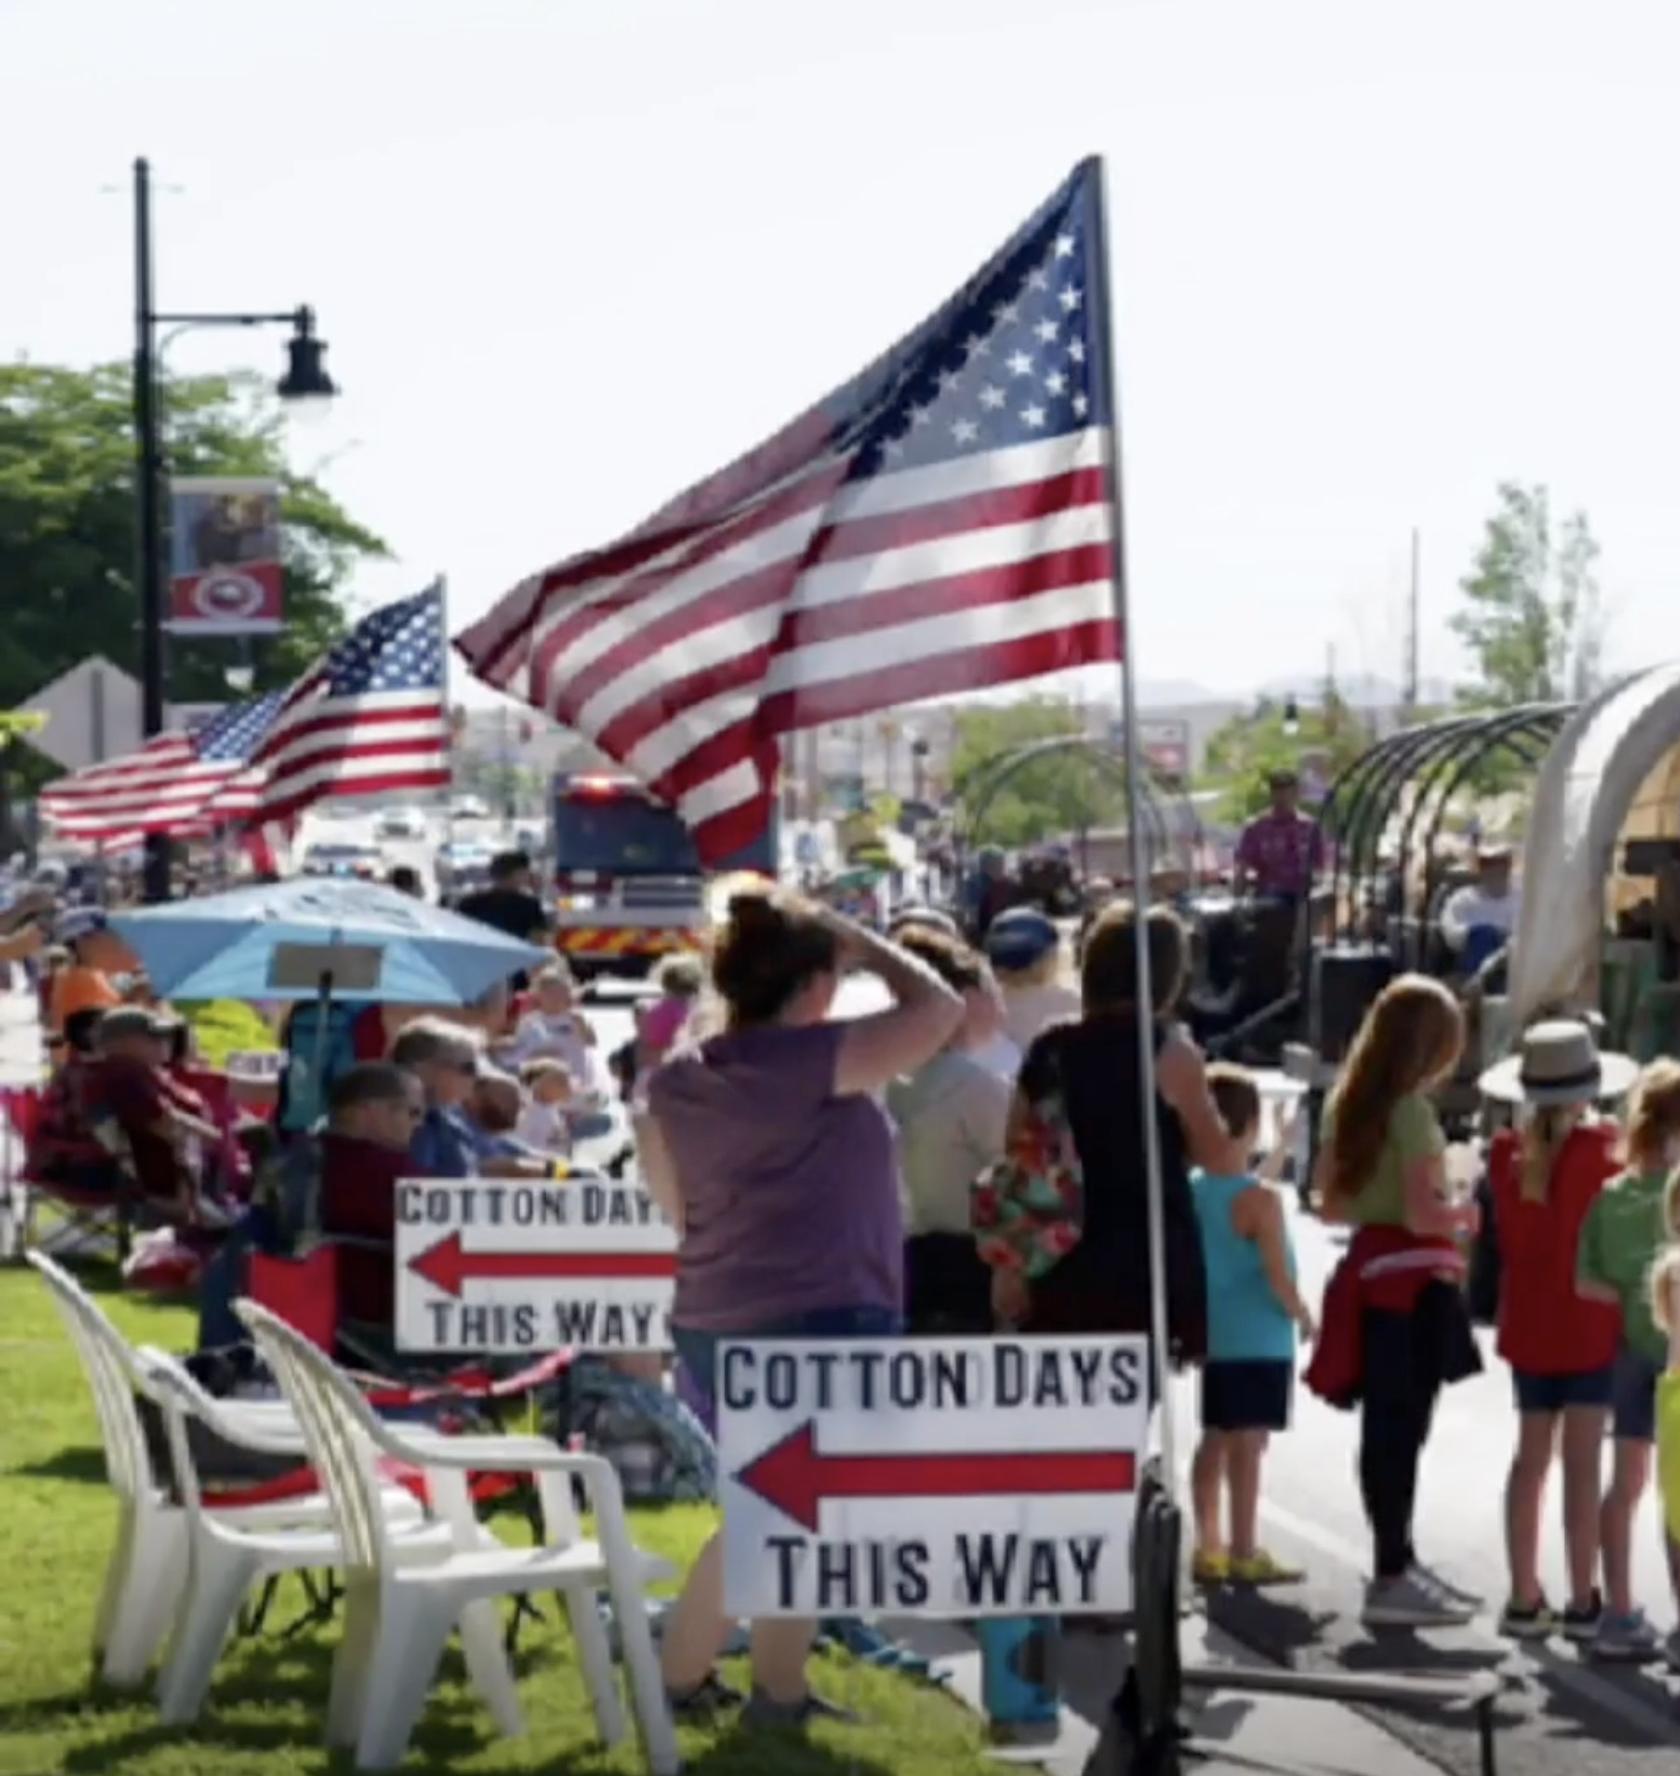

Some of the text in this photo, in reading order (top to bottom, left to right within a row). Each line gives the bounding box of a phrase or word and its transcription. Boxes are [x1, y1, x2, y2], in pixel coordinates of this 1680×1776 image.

[400, 1184, 673, 1228] COTTON DAY
[426, 1298, 658, 1347] THIS WAY
[723, 1344, 1140, 1412] COTTON DAYS
[767, 1533, 1104, 1609] THIS WAY
